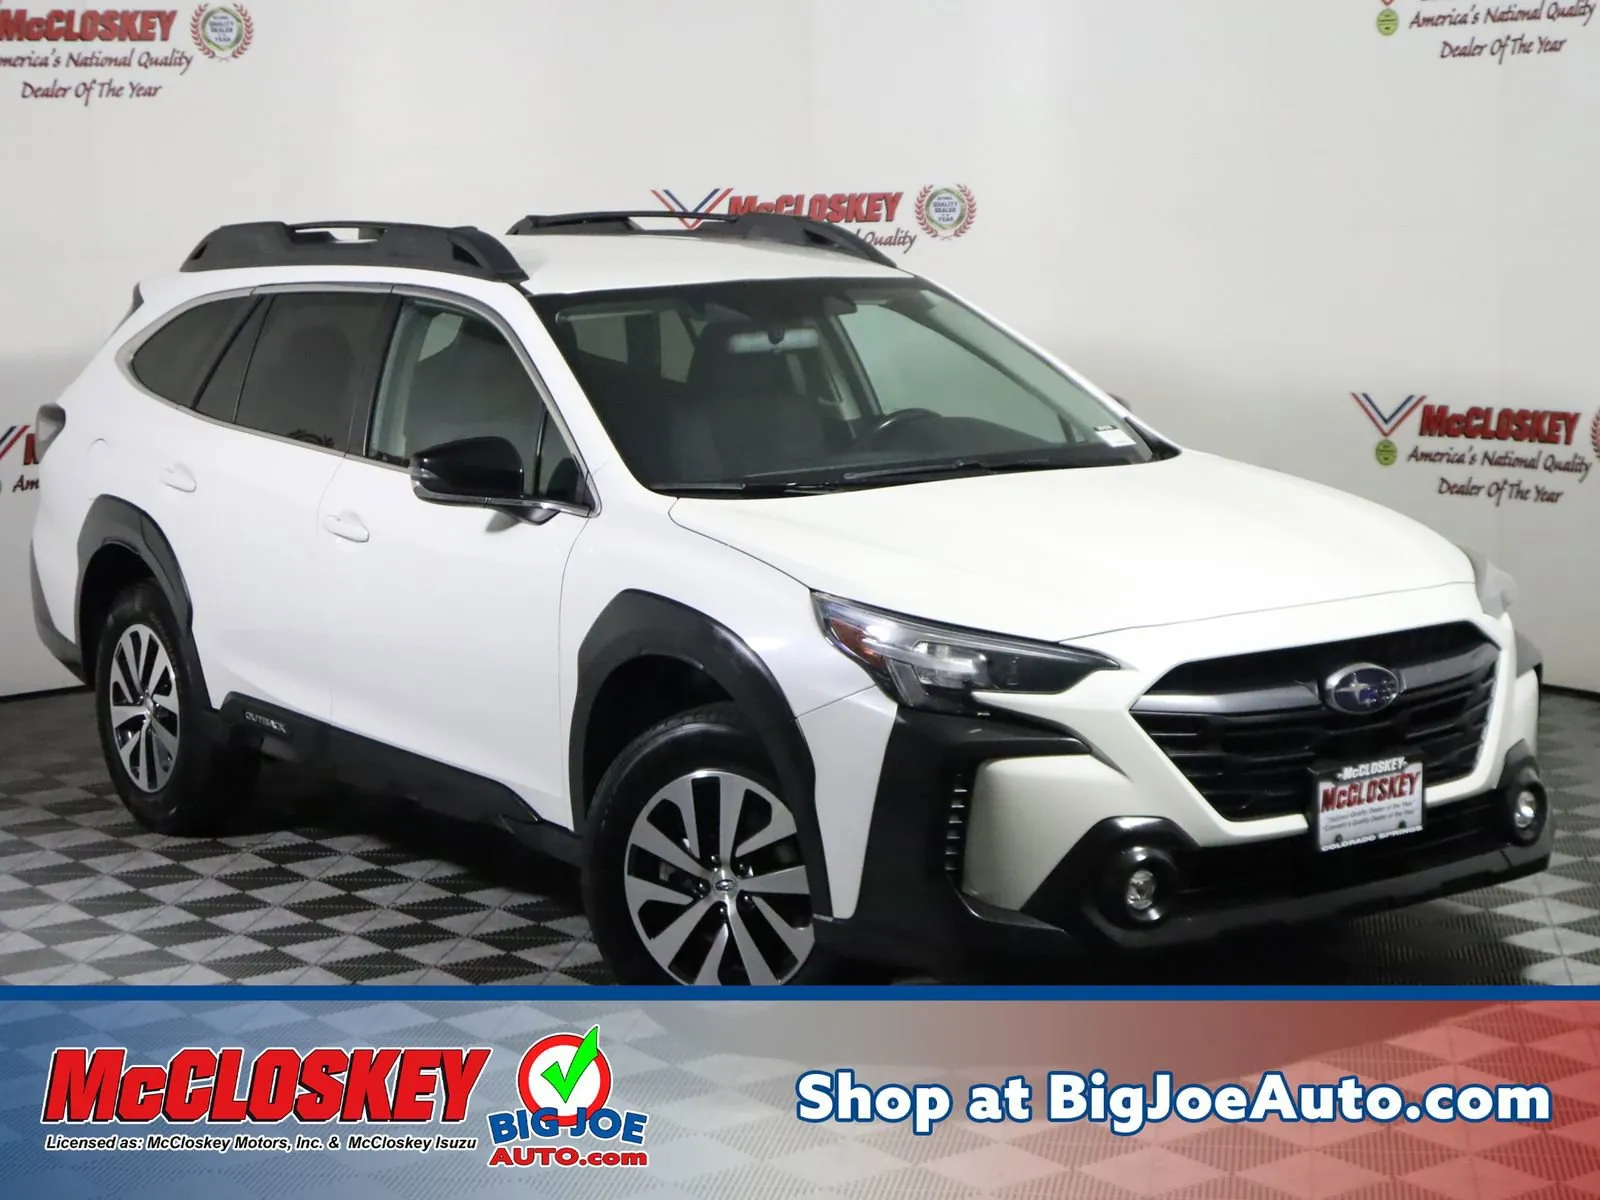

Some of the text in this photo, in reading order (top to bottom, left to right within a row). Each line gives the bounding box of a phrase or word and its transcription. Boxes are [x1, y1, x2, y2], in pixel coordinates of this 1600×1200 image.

[0, 9, 177, 41] McCLOSKEY
[1408, 0, 1596, 29] America's National Quality
[0, 48, 194, 75] merica's National Quality
[1440, 33, 1568, 65] Dealer Of The Year
[21, 78, 163, 106] Dealer Of The Year
[863, 230, 917, 254] Quality
[1419, 403, 1582, 446] McCLOSKEY
[1406, 445, 1593, 483] America's National Quality
[1437, 477, 1565, 508] Dealer Of The Year
[1321, 771, 1421, 813] McCLOSKEY
[1321, 825, 1423, 852] COLORADO SPRINGS
